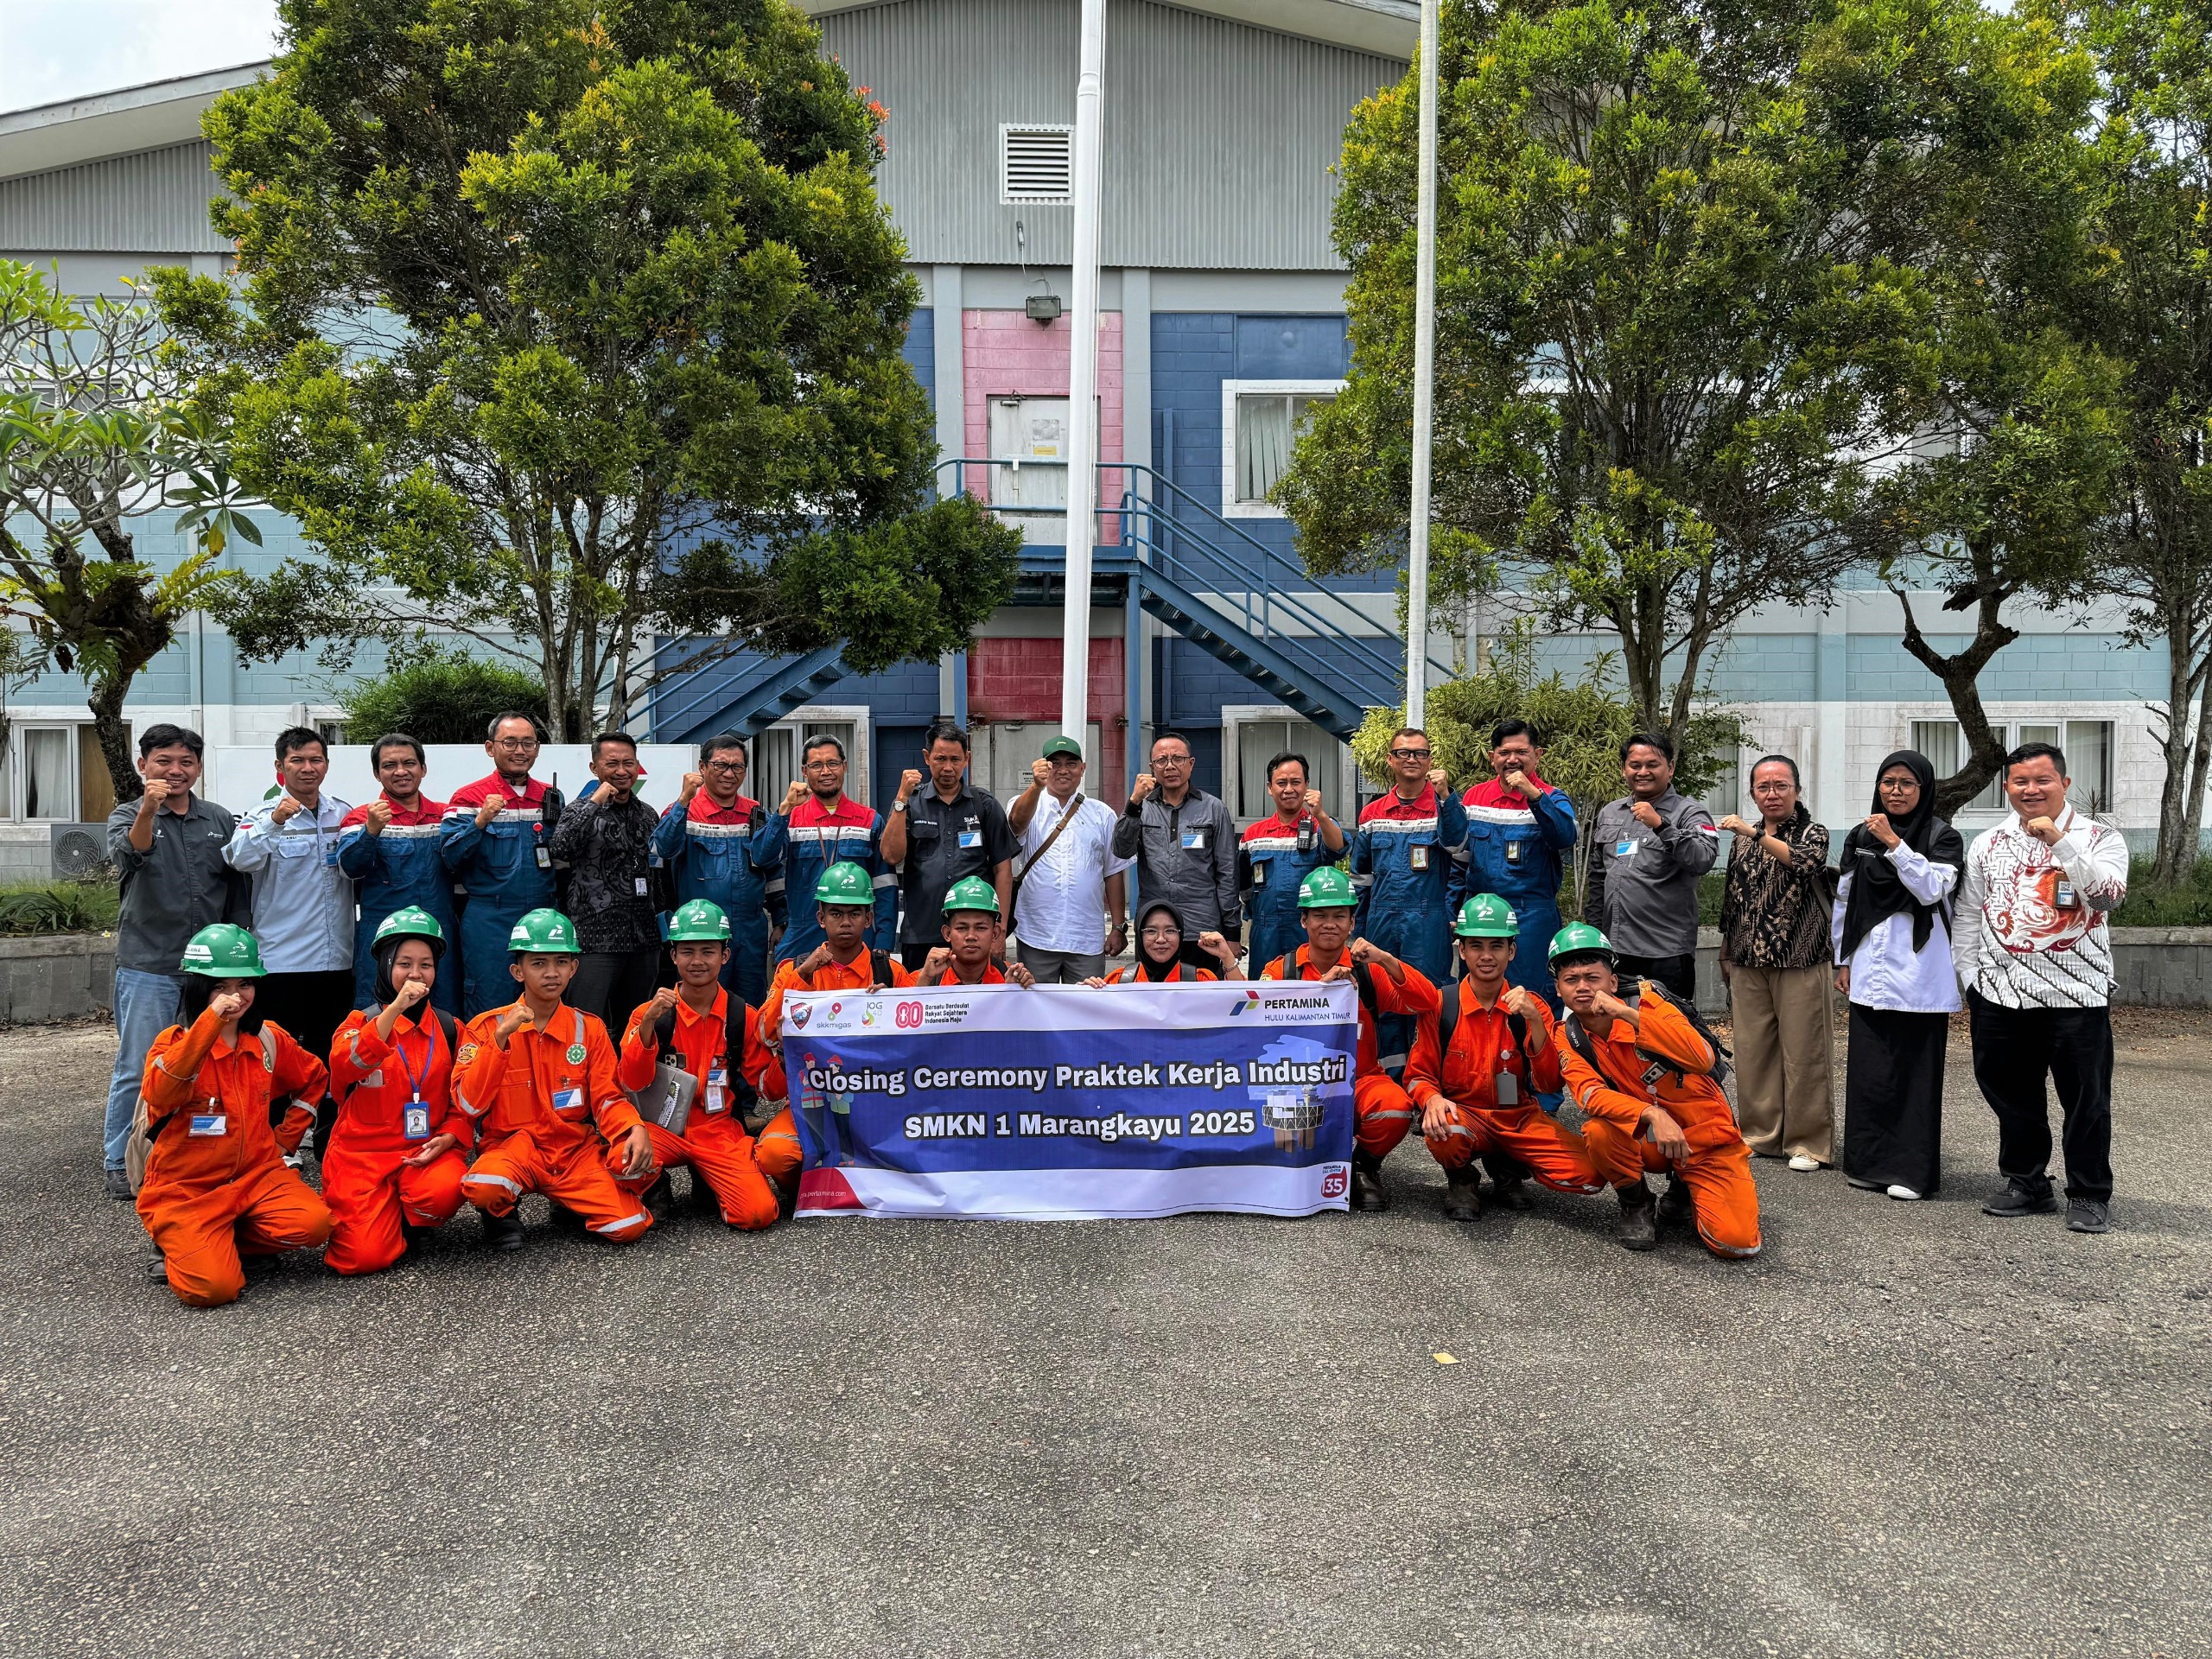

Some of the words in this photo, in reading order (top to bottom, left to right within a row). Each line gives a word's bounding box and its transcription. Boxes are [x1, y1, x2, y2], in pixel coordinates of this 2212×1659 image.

[1264, 998, 1330, 1009] PERTAMINA
[809, 1069, 906, 1096] Closing
[913, 1067, 1047, 1090] Ceremony
[1056, 1063, 1160, 1087] Praktek
[1168, 1061, 1241, 1089] Kerja
[1249, 1058, 1345, 1083] Industri
[905, 1114, 986, 1138] SMKN
[996, 1116, 1011, 1135] 1
[1020, 1114, 1181, 1141] Marangkayu
[1190, 1111, 1255, 1135] 2025
